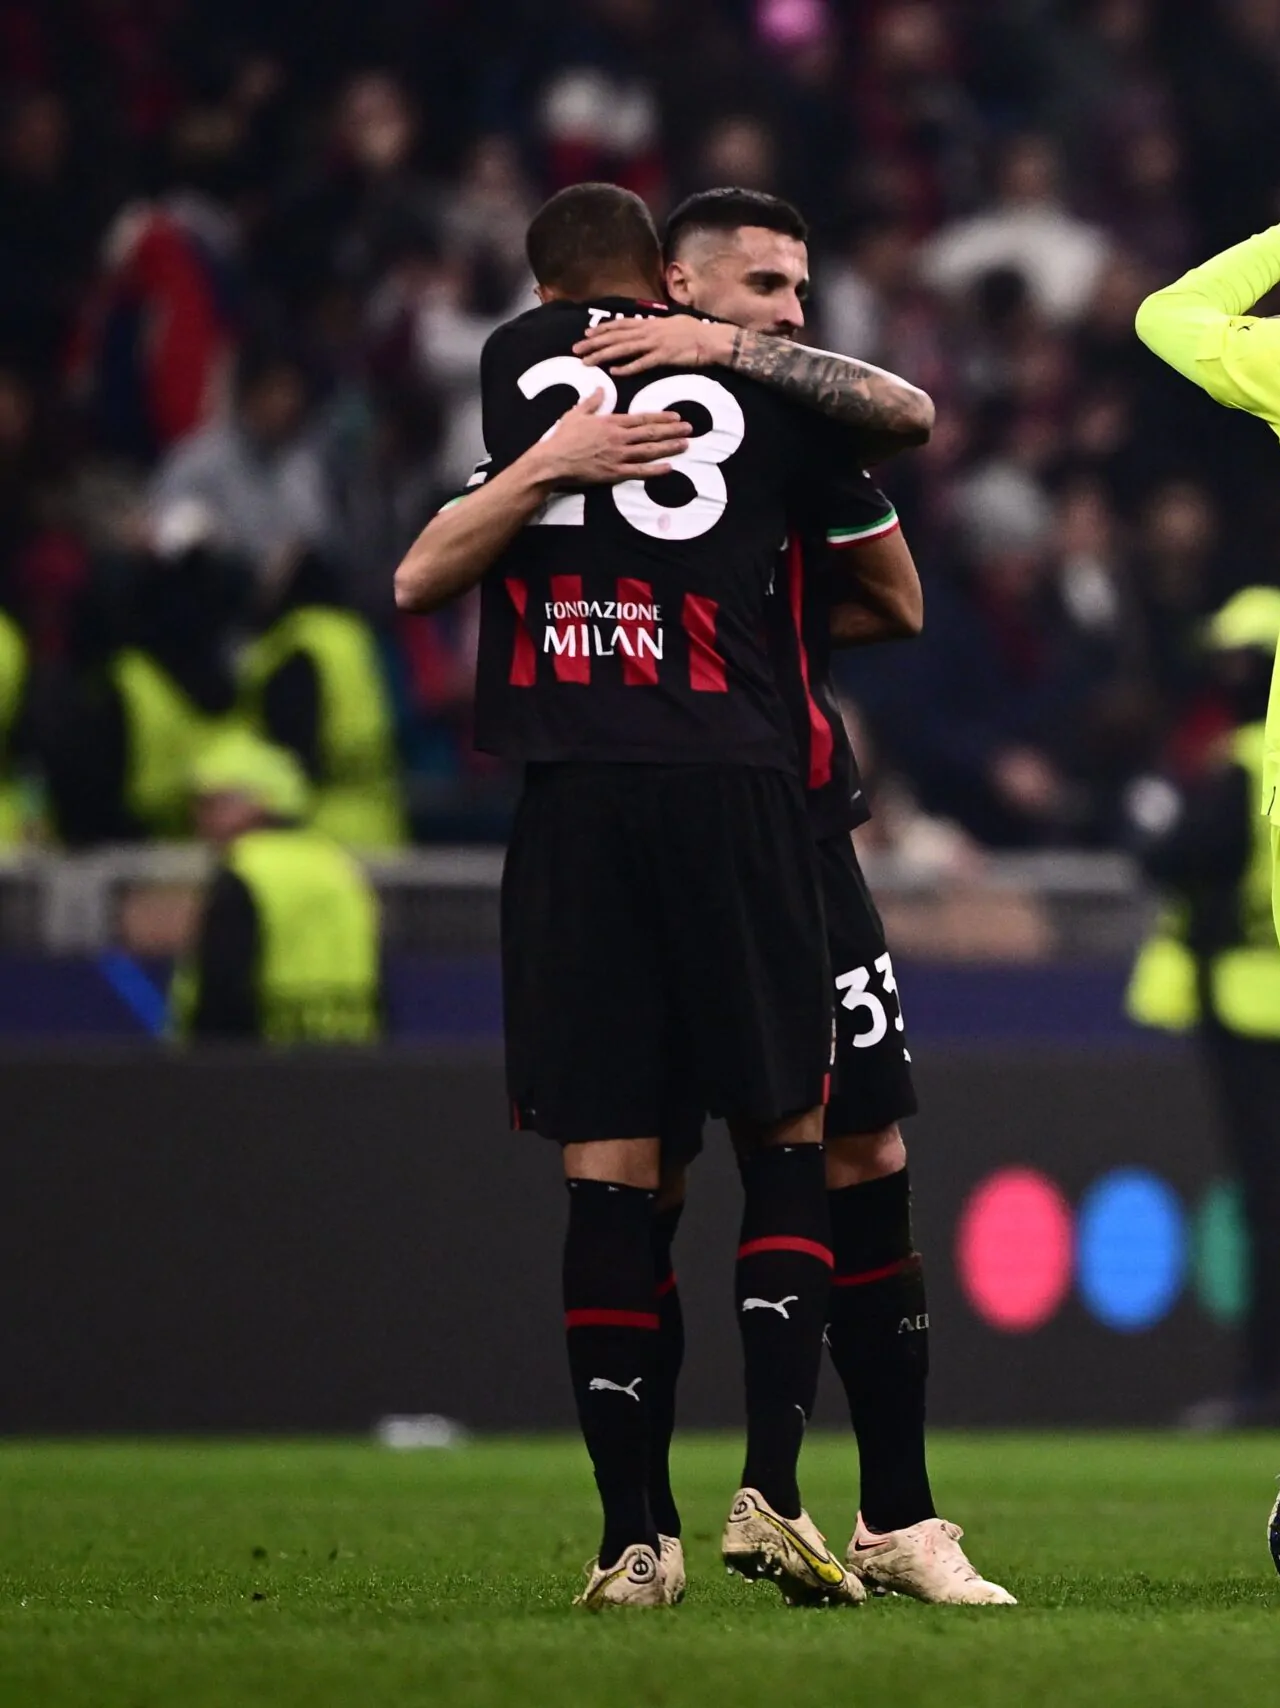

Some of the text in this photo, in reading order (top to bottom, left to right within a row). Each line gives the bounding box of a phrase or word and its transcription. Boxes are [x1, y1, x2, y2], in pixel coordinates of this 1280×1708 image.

[517, 356, 745, 540] 28
[544, 600, 662, 622] FONDAZIONE
[543, 625, 664, 660] MILAN
